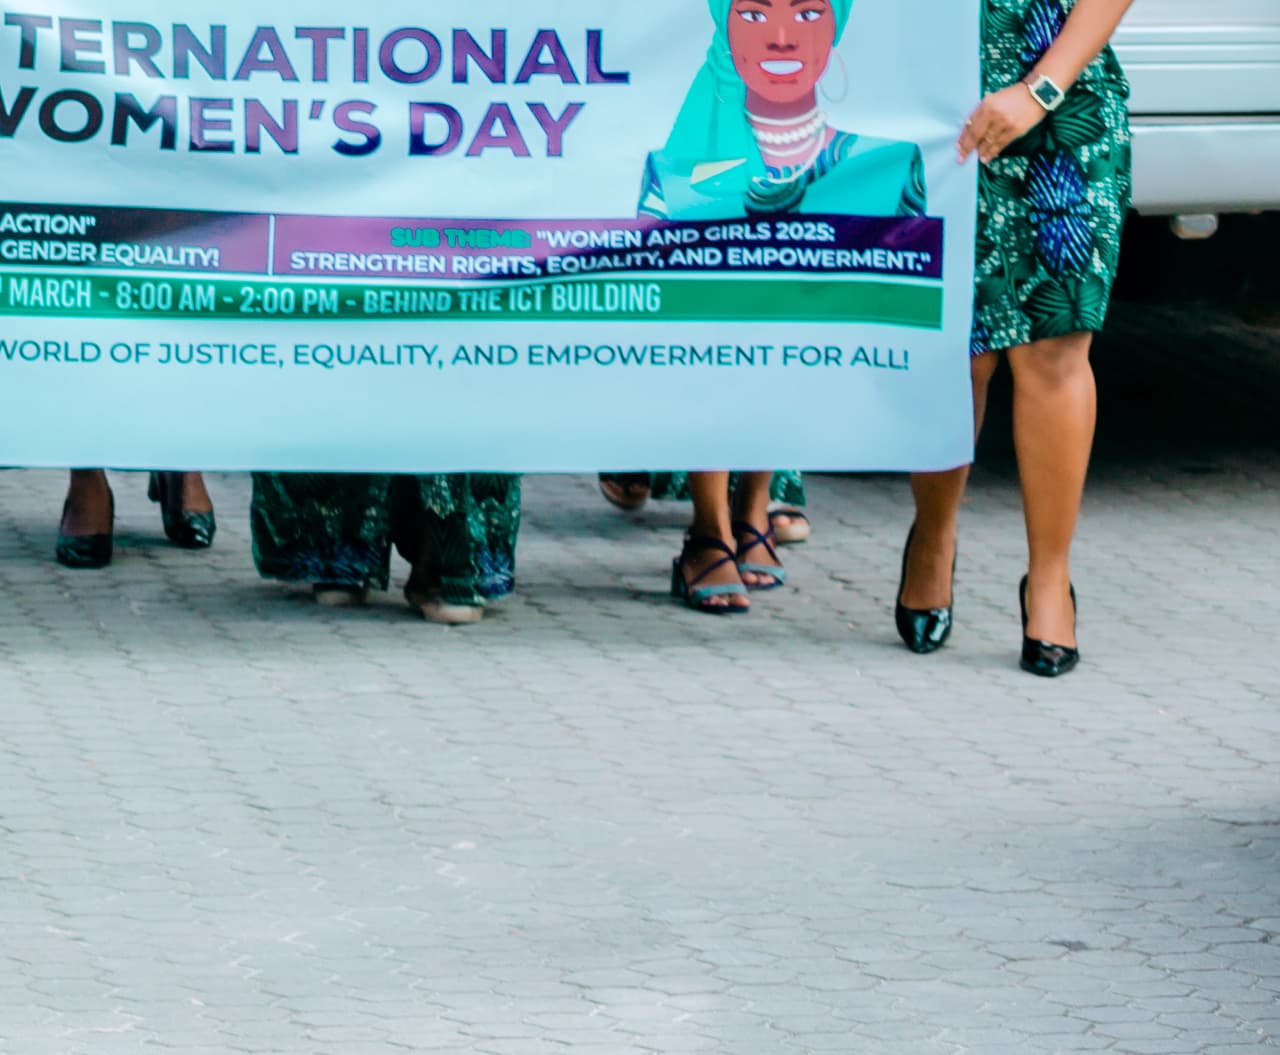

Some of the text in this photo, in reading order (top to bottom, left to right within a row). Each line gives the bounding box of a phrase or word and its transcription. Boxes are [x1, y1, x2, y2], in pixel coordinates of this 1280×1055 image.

[407, 101, 587, 158] DAY
[391, 227, 441, 248] SUB
[536, 229, 642, 249] "WOMEN
[647, 228, 699, 246] AND
[704, 224, 771, 243] GIRLS
[775, 222, 835, 242] 2025:
[0, 239, 97, 262] GENDER
[100, 243, 220, 267] EQUALITY!
[291, 247, 931, 276] STRENGTHEN RIGHTS, EQUALITY, AND EMPOWERMENT."
[9, 278, 91, 308] MARCH
[115, 281, 172, 312] 8:00
[178, 284, 216, 312] AM
[239, 286, 295, 314] 2:00
[301, 289, 338, 314] PM
[363, 289, 452, 313] BEHIND
[457, 289, 503, 312] THE
[509, 285, 545, 311] ICT
[552, 283, 661, 313] BUILDING
[109, 342, 152, 364] OF
[157, 342, 284, 368] JUSTICE,
[293, 344, 443, 369] EQUALITY,
[451, 344, 518, 365] AND
[528, 344, 774, 367] EMPOWERMENT
[782, 345, 842, 367] FOR
[850, 346, 910, 371] ALL!
